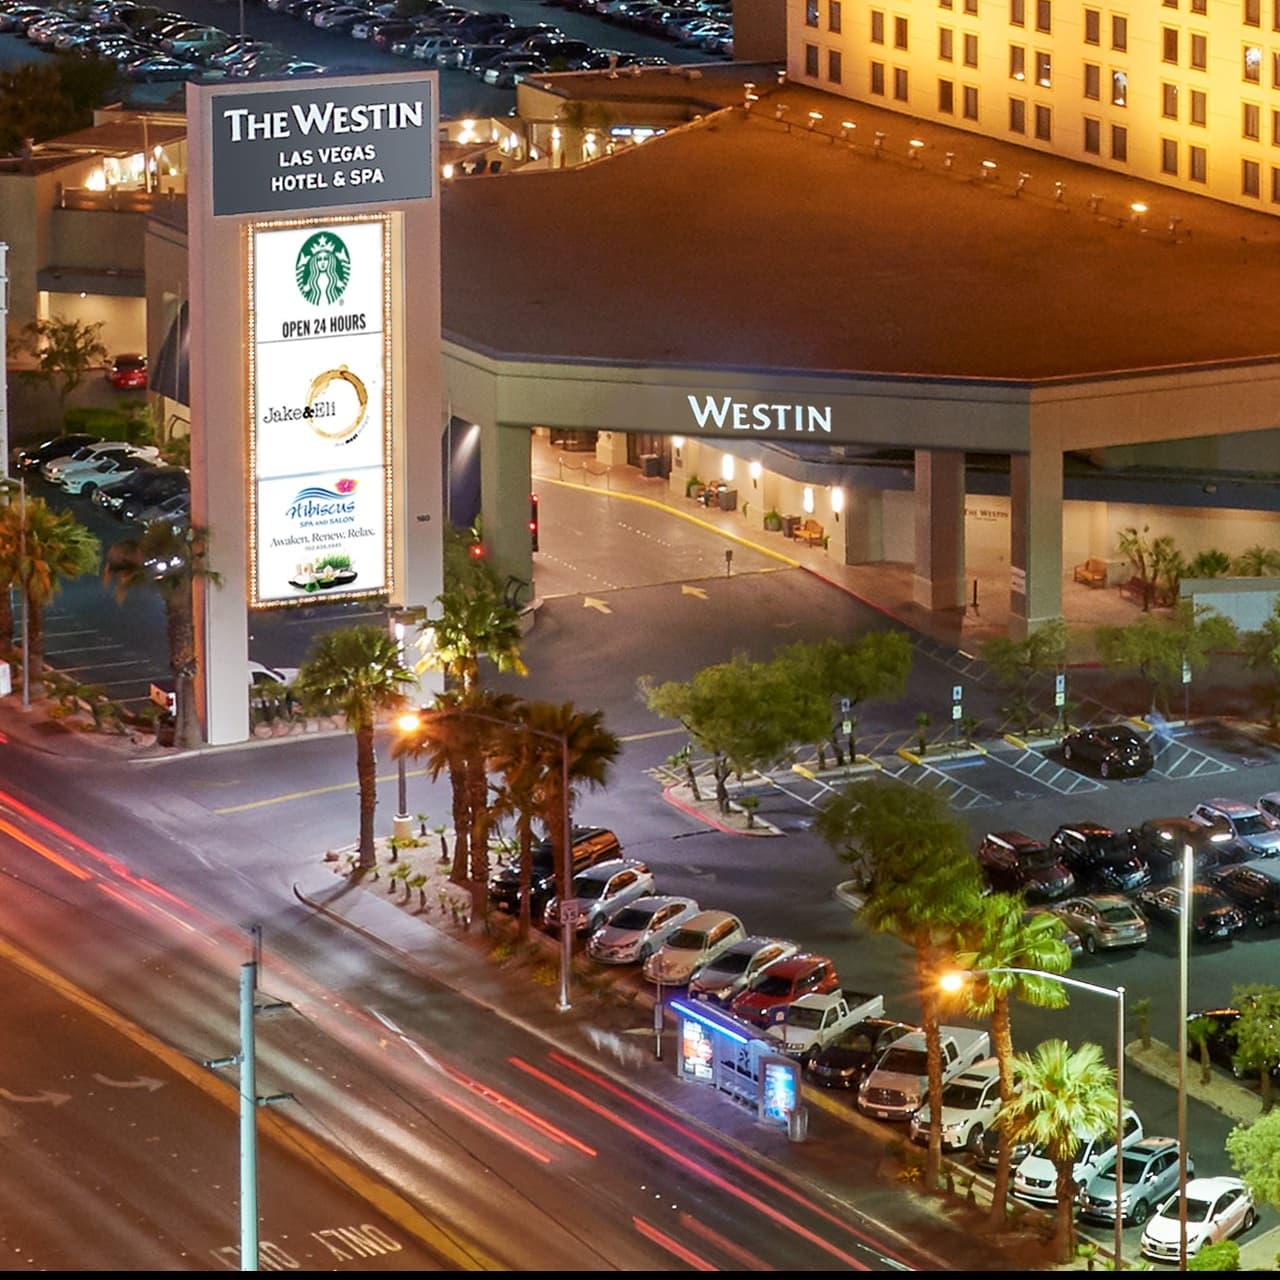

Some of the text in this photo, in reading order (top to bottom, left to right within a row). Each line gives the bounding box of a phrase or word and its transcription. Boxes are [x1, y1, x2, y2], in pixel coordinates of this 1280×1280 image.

[224, 101, 423, 142] THE WESTIN
[279, 144, 376, 168] LAS VEGAS
[271, 168, 385, 192] HOTEL & SPA
[282, 313, 367, 339] OPEN 24 HOURS
[687, 395, 832, 433] WESTIN
[299, 520, 314, 529] SPA
[329, 515, 355, 526] SALON
[310, 1223, 403, 1262] ONLY
